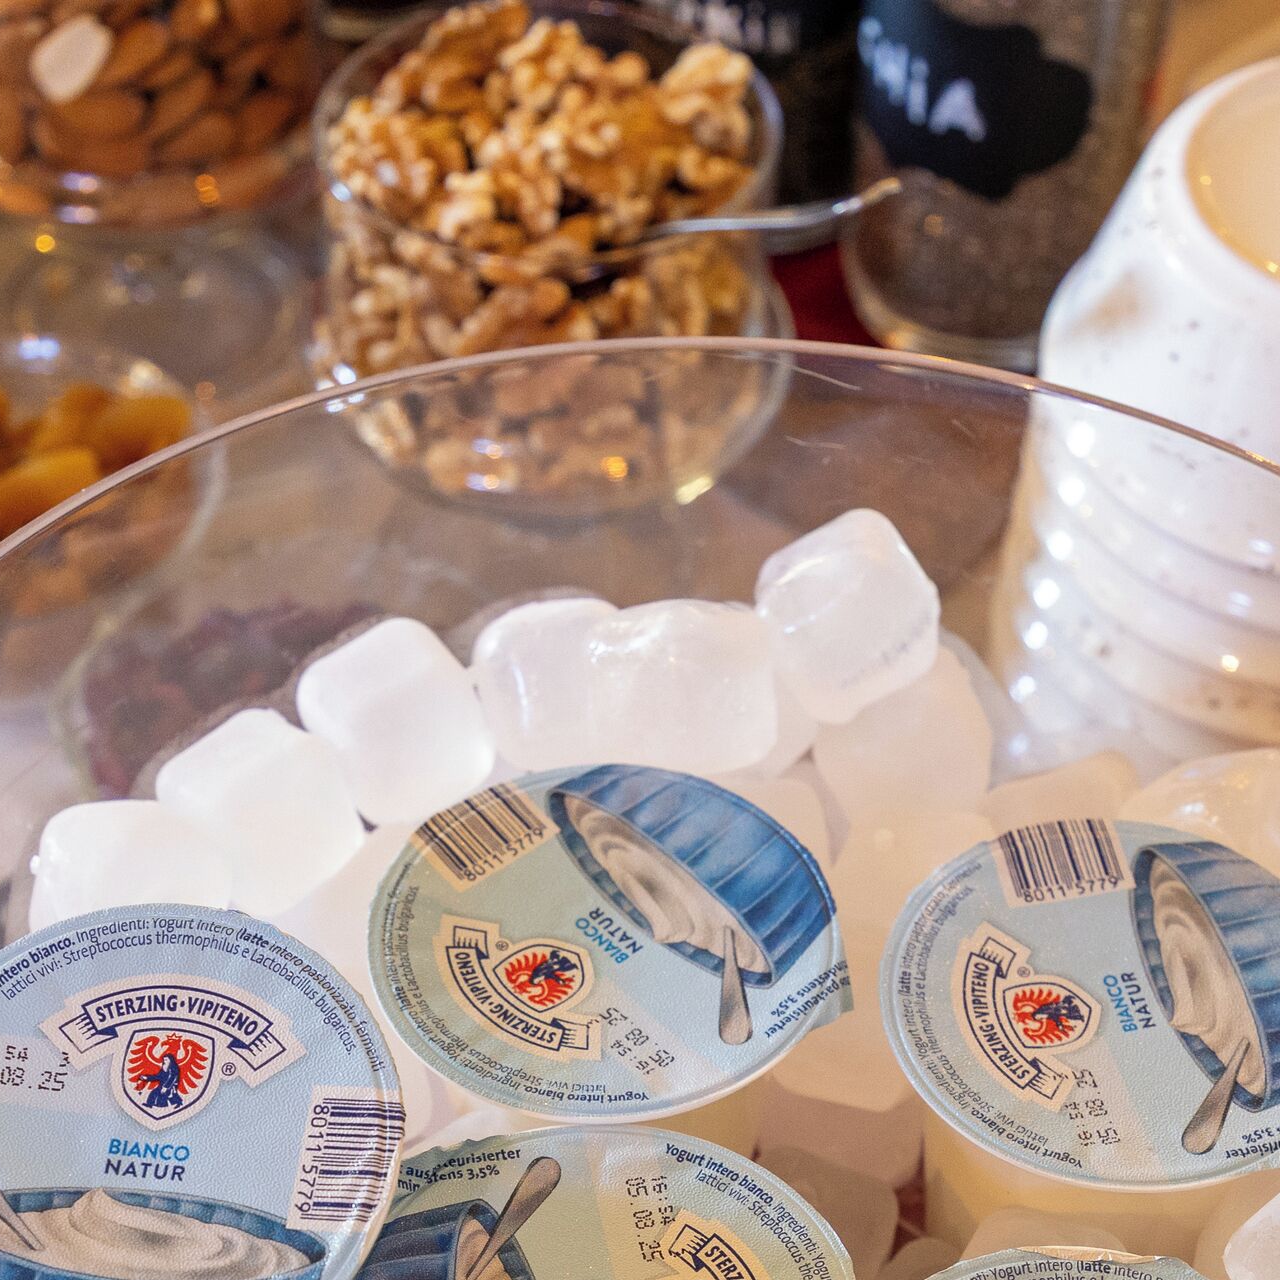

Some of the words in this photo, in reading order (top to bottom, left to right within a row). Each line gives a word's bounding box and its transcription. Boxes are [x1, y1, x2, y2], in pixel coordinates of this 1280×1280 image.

[574, 917, 630, 964] BIANCO
[588, 907, 644, 954] NATUR
[1, 973, 38, 1001] lattici
[36, 956, 63, 981] vivi:
[64, 931, 153, 965] Streptococcus
[155, 929, 240, 957] thermophilus
[241, 947, 250, 959] e
[249, 948, 319, 1001] Lactobacillus
[29, 935, 76, 964] bianco.
[75, 919, 149, 943] Ingredienti:
[152, 917, 194, 933] Yogurt
[196, 919, 235, 937] intero
[235, 926, 270, 949] (latte
[268, 941, 305, 968] intero
[355, 1020, 387, 1073] fermenti
[1102, 974, 1139, 1034] BIANCO
[1120, 971, 1157, 1030] NATUR
[607, 1091, 649, 1102] Yogurt
[104, 1158, 186, 1182] NATUR
[108, 1138, 191, 1162] BIANCO
[467, 1164, 500, 1181] 3,5%
[665, 1142, 706, 1168] Yogurt
[704, 1156, 741, 1183] intero
[773, 1202, 820, 1256] Ingredienti:
[695, 1169, 728, 1193] lattici
[728, 1187, 750, 1206] vivi:
[748, 1200, 805, 1265] Streptococcus
[1034, 1260, 1073, 1273] intero
[1077, 1259, 1111, 1275] (latte
